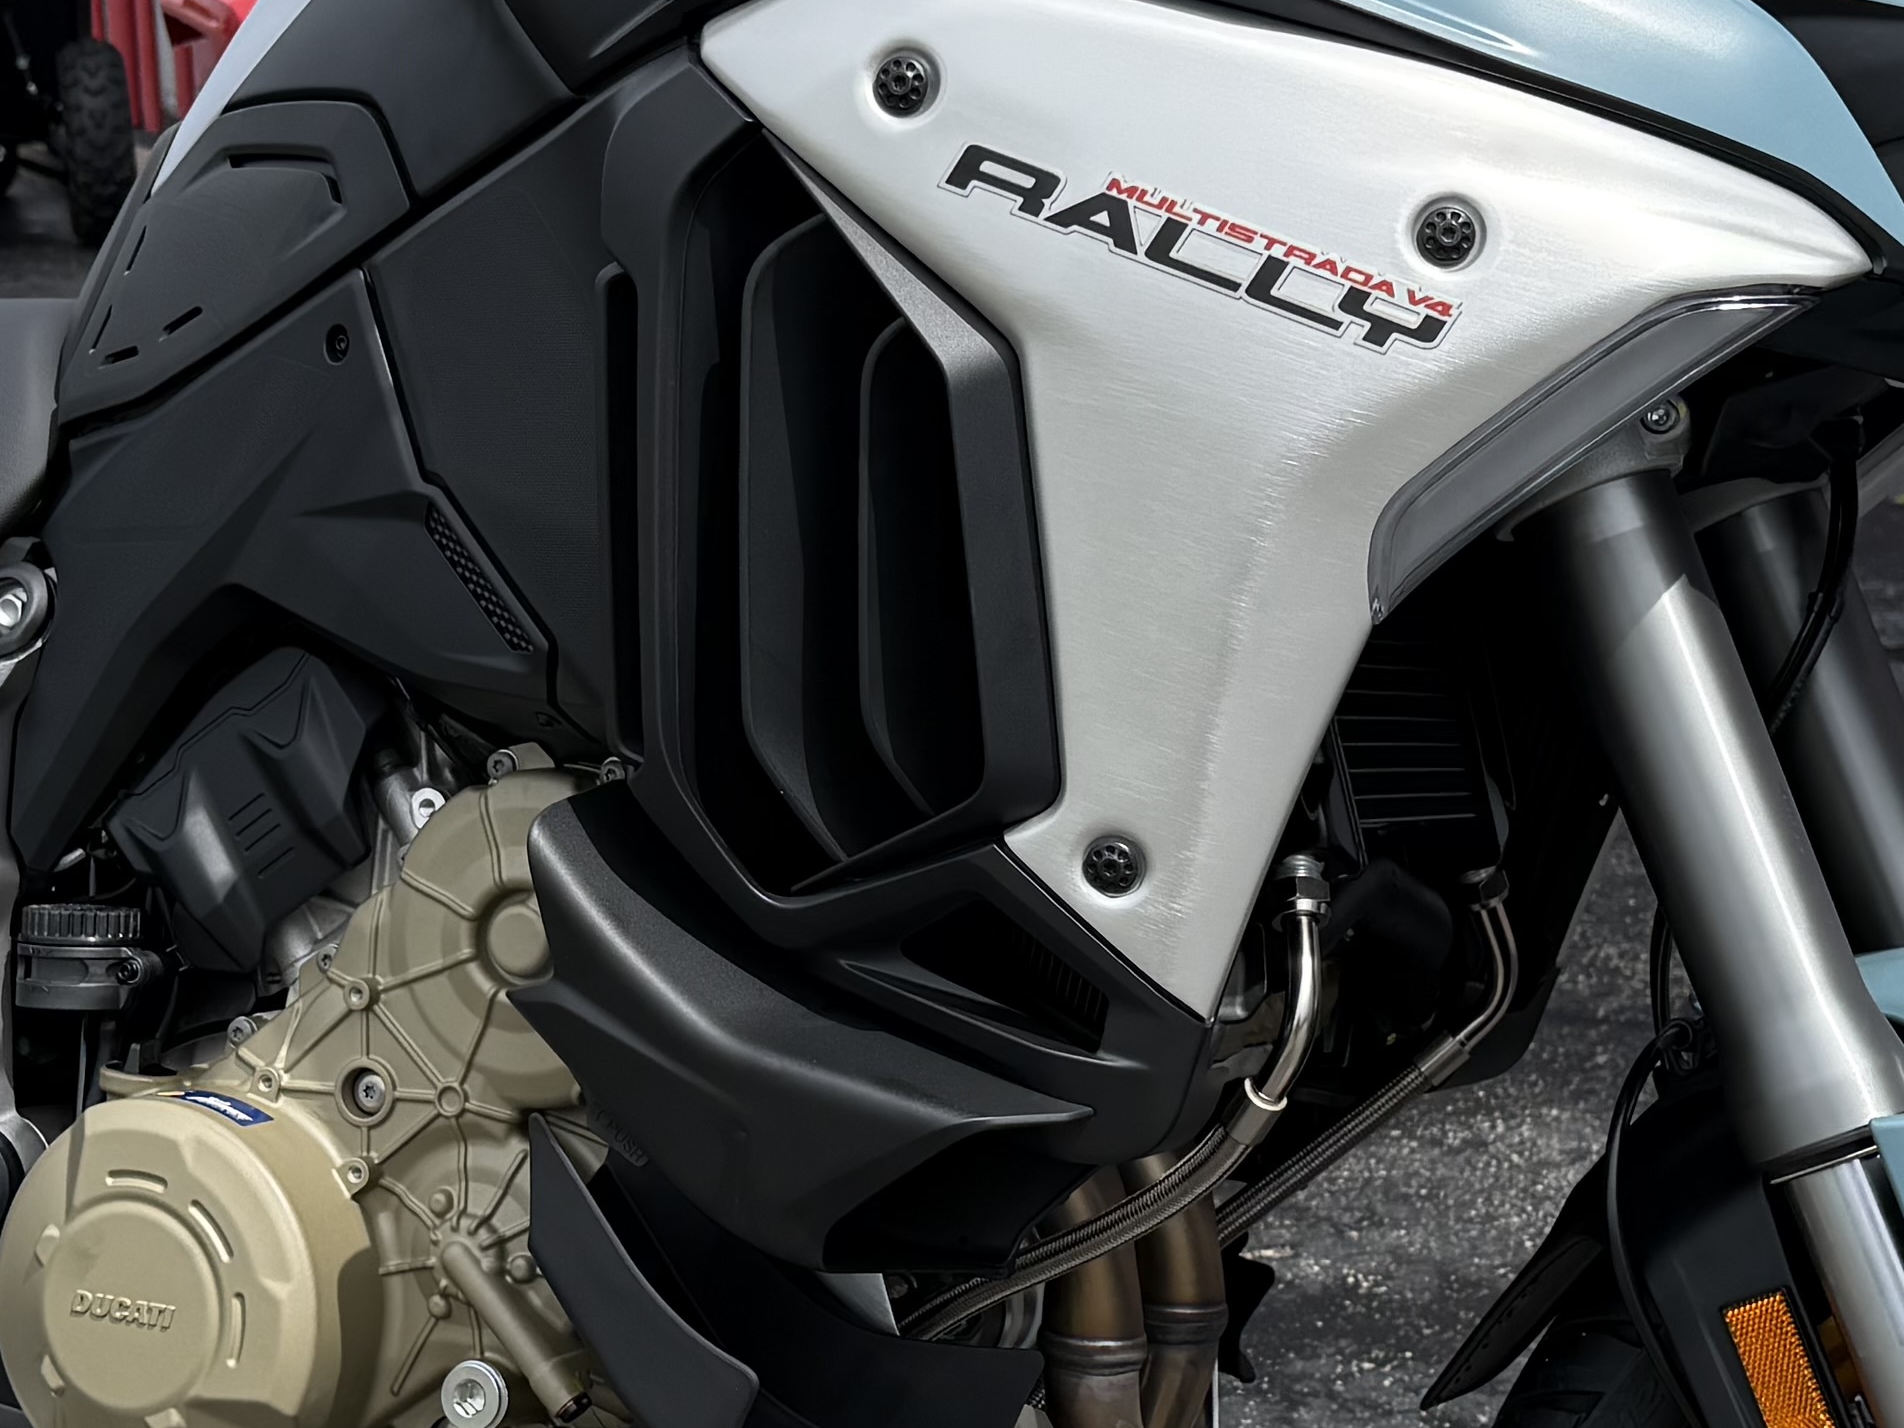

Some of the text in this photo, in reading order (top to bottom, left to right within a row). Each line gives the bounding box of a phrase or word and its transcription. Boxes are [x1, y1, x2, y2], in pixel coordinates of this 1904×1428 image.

[943, 143, 1450, 350] RALLY
[1106, 175, 1455, 320] MULTISTRADA V4
[70, 1288, 176, 1332] DUCATI
